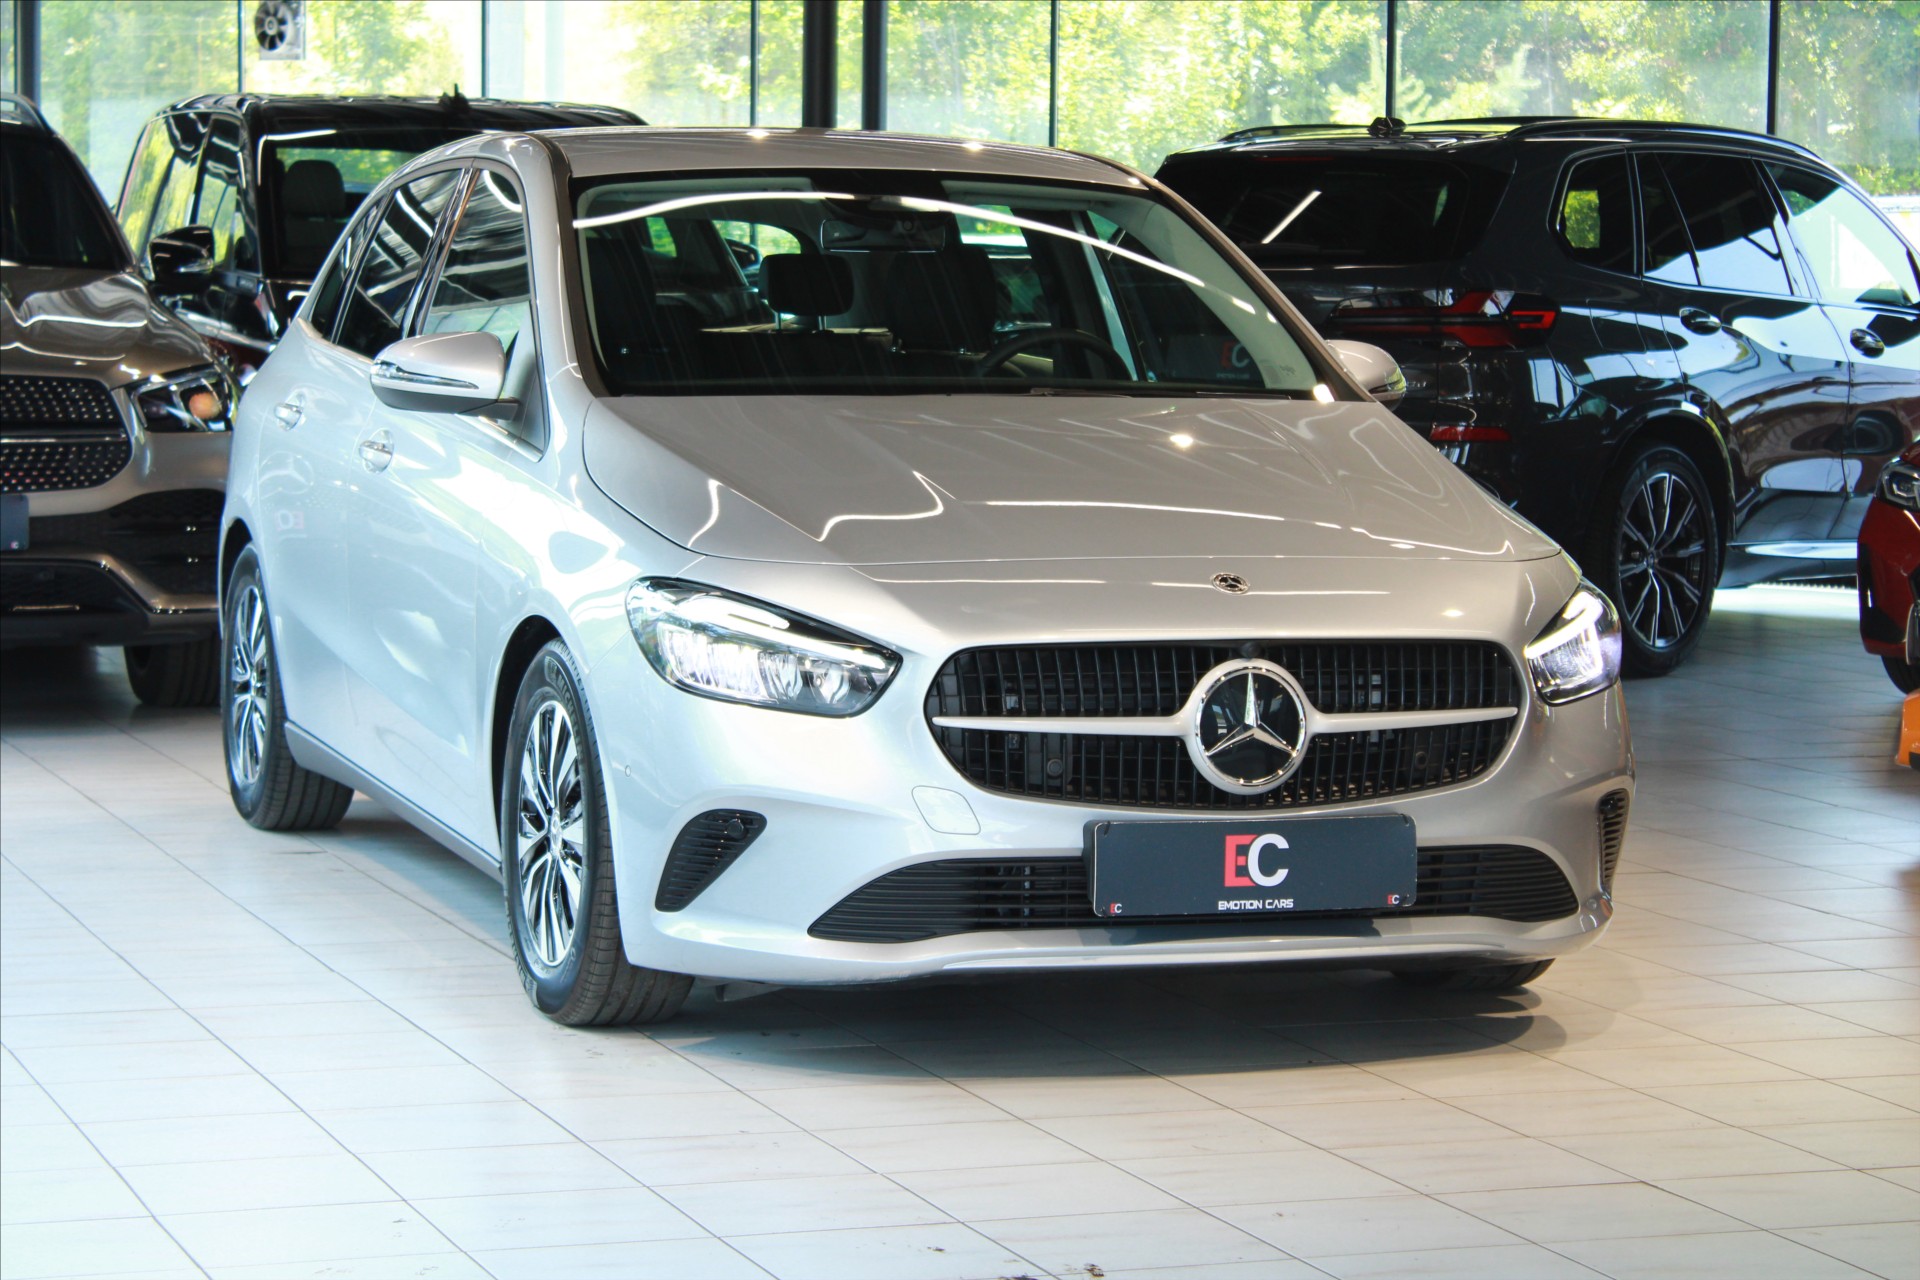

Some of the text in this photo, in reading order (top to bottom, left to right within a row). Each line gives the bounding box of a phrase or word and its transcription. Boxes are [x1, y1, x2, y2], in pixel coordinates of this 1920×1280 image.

[1224, 833, 1290, 887] EC
[1218, 899, 1294, 910] EMOTION CARS
